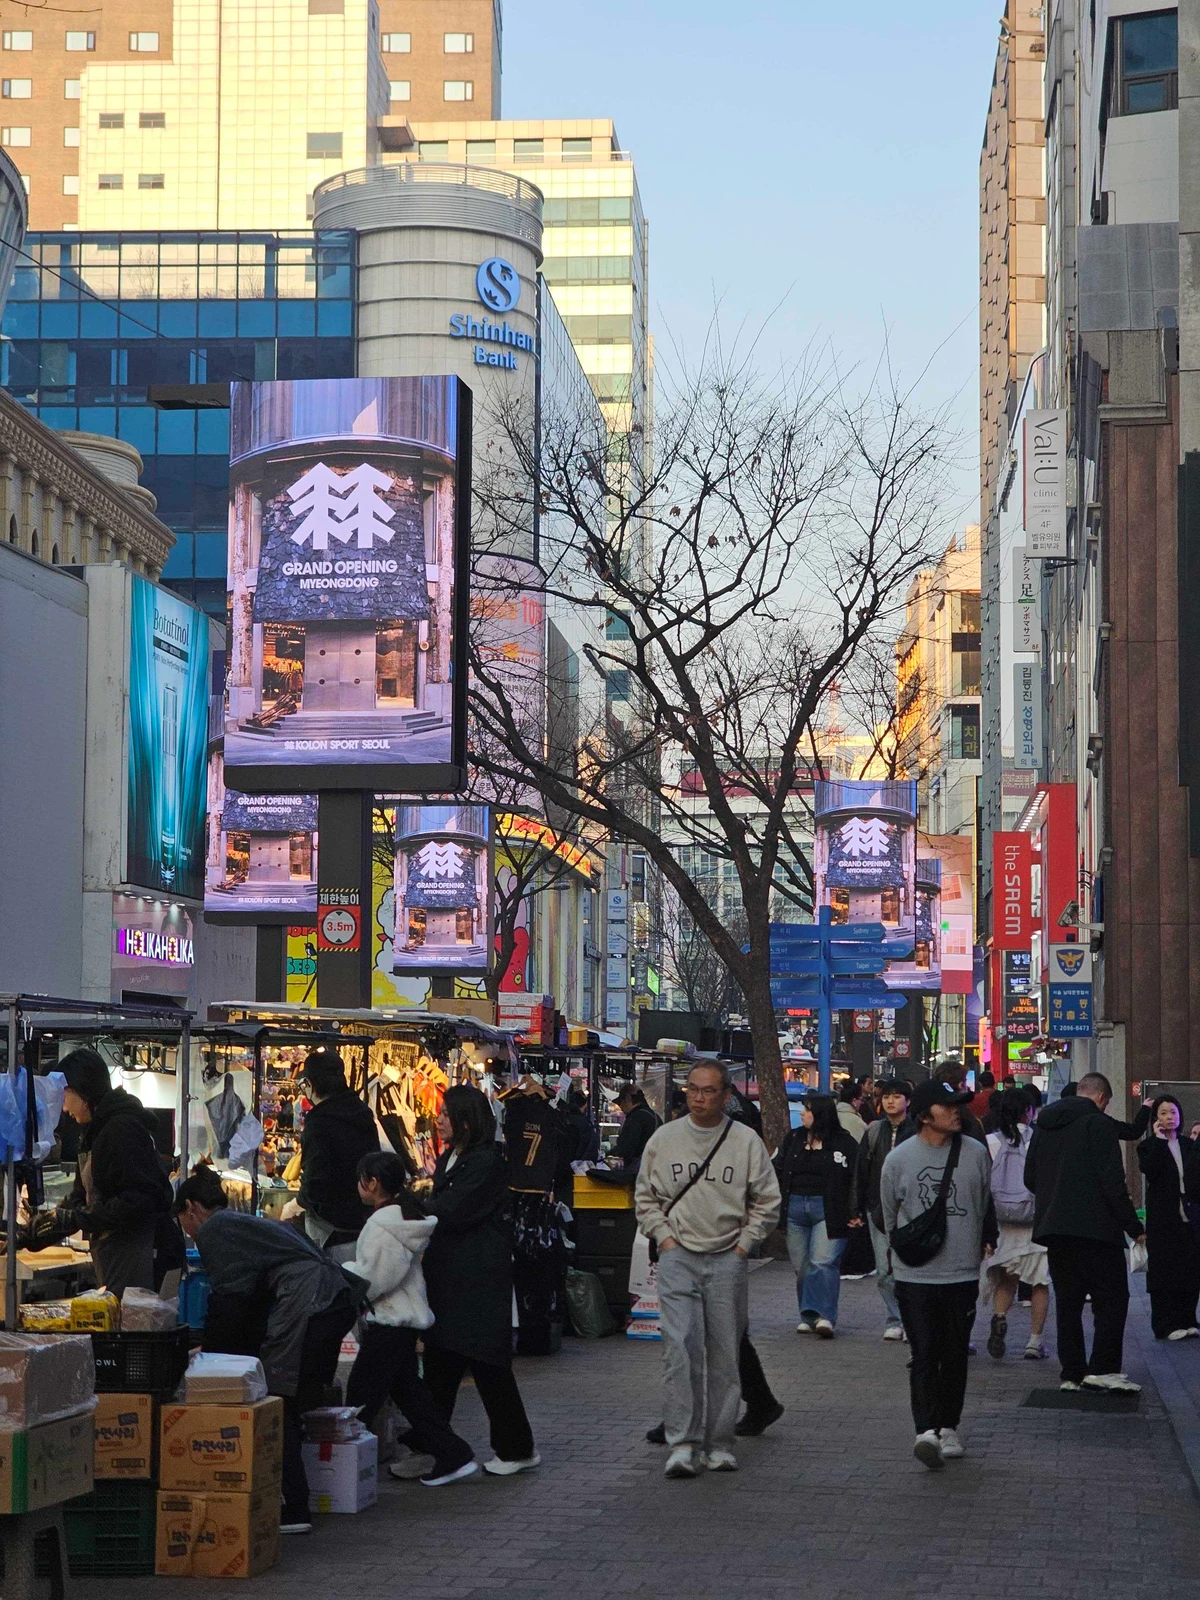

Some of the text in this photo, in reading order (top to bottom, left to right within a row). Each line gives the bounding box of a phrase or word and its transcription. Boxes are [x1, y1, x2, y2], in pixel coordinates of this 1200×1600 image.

[450, 314, 534, 352] Shinhan
[474, 345, 518, 370] Bank
[1034, 416, 1058, 484] Val:U
[1033, 489, 1058, 498] clinic
[1040, 520, 1051, 528] 4F
[1031, 532, 1060, 542] 벨유의원
[1039, 542, 1060, 550] 피부과
[282, 560, 398, 576] GRAND OPENING
[300, 577, 380, 589] MYEONGDONG
[1020, 583, 1033, 598] 足
[1022, 667, 1032, 702] 김동진
[1022, 706, 1034, 756] 성형외과
[296, 740, 391, 750] KOLON SPORT SEOUL
[238, 797, 302, 805] GRAND OPENING
[1004, 846, 1020, 871] the
[320, 894, 360, 904] 제한높이
[326, 922, 354, 932] 3.5m
[856, 962, 870, 970] Taipei
[1020, 998, 1032, 1006] WE
[526, 1122, 540, 1131] SON
[523, 1131, 542, 1166] 7
[671, 1162, 734, 1184] POLO
